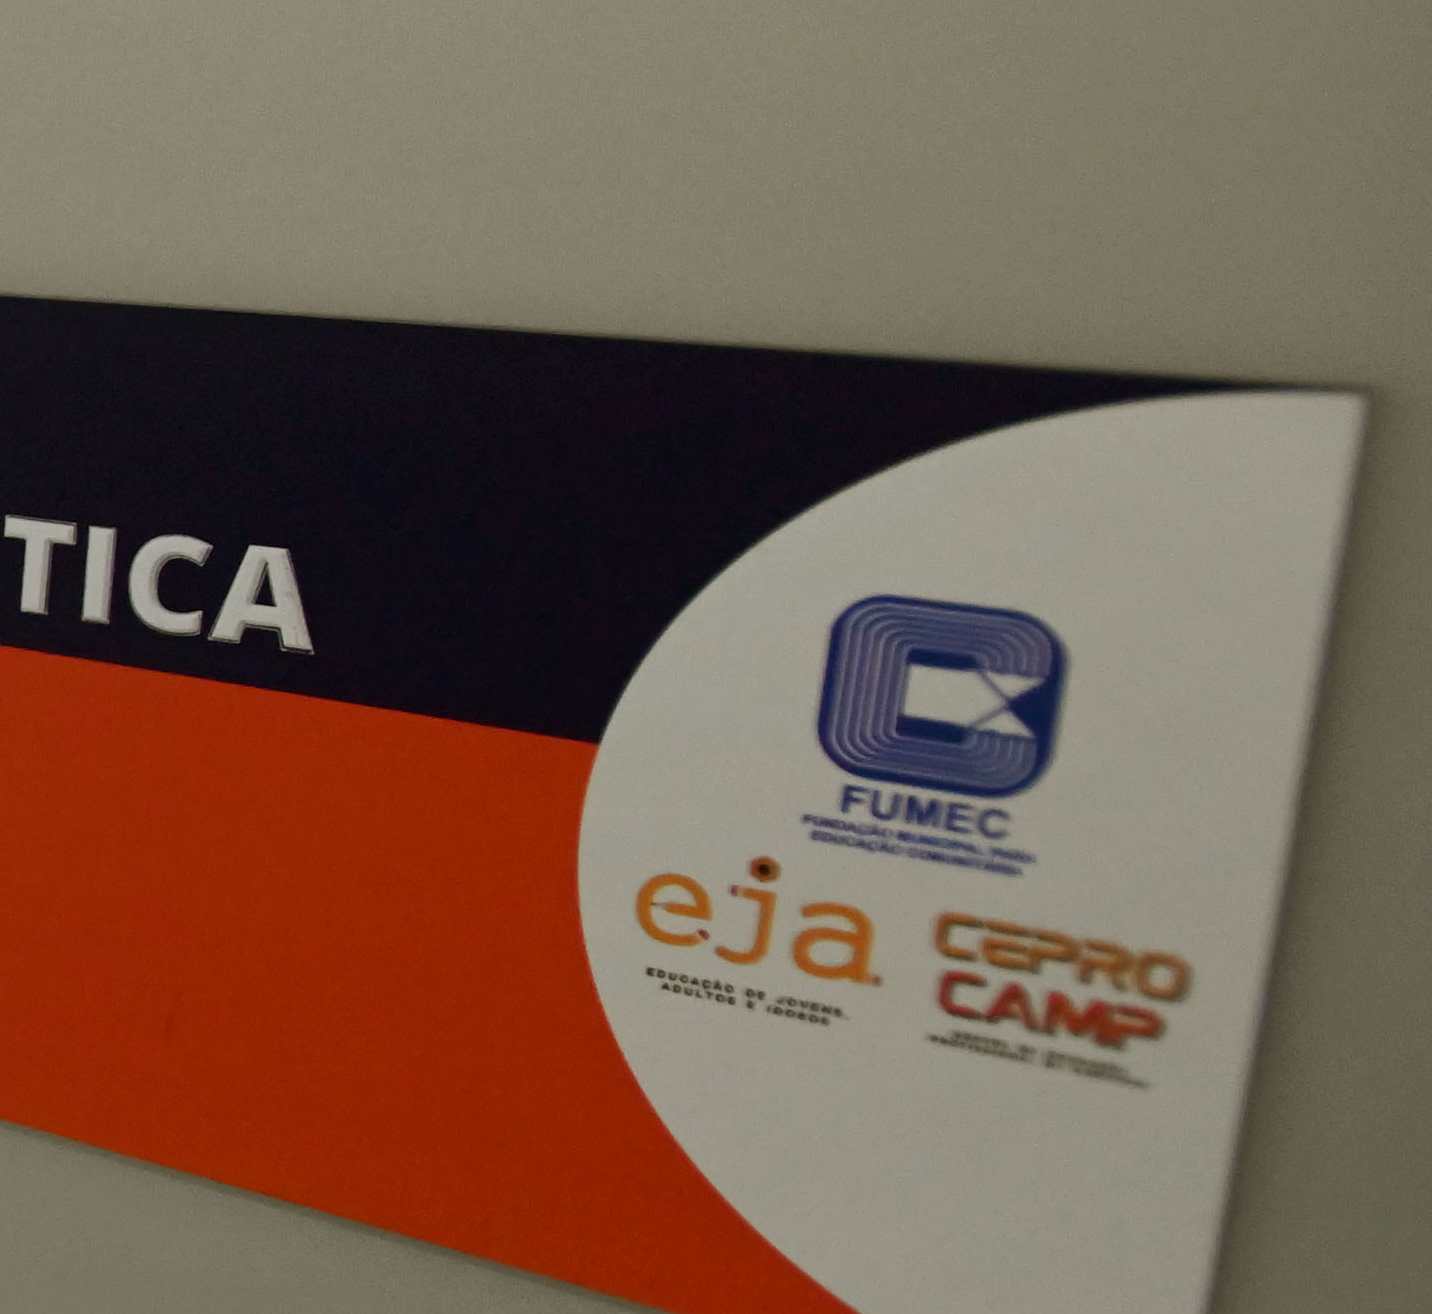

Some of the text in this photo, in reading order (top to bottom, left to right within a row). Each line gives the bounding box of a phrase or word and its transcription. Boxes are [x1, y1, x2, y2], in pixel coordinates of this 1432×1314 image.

[840, 784, 1011, 840] FUMEC
[635, 855, 883, 985] eja
[646, 966, 735, 995] EDUCAÇÃO
[745, 987, 766, 1001] DE
[934, 911, 1193, 1002] CEPRO
[661, 982, 737, 1006] ADULTOS
[937, 970, 1166, 1049] CAMP
